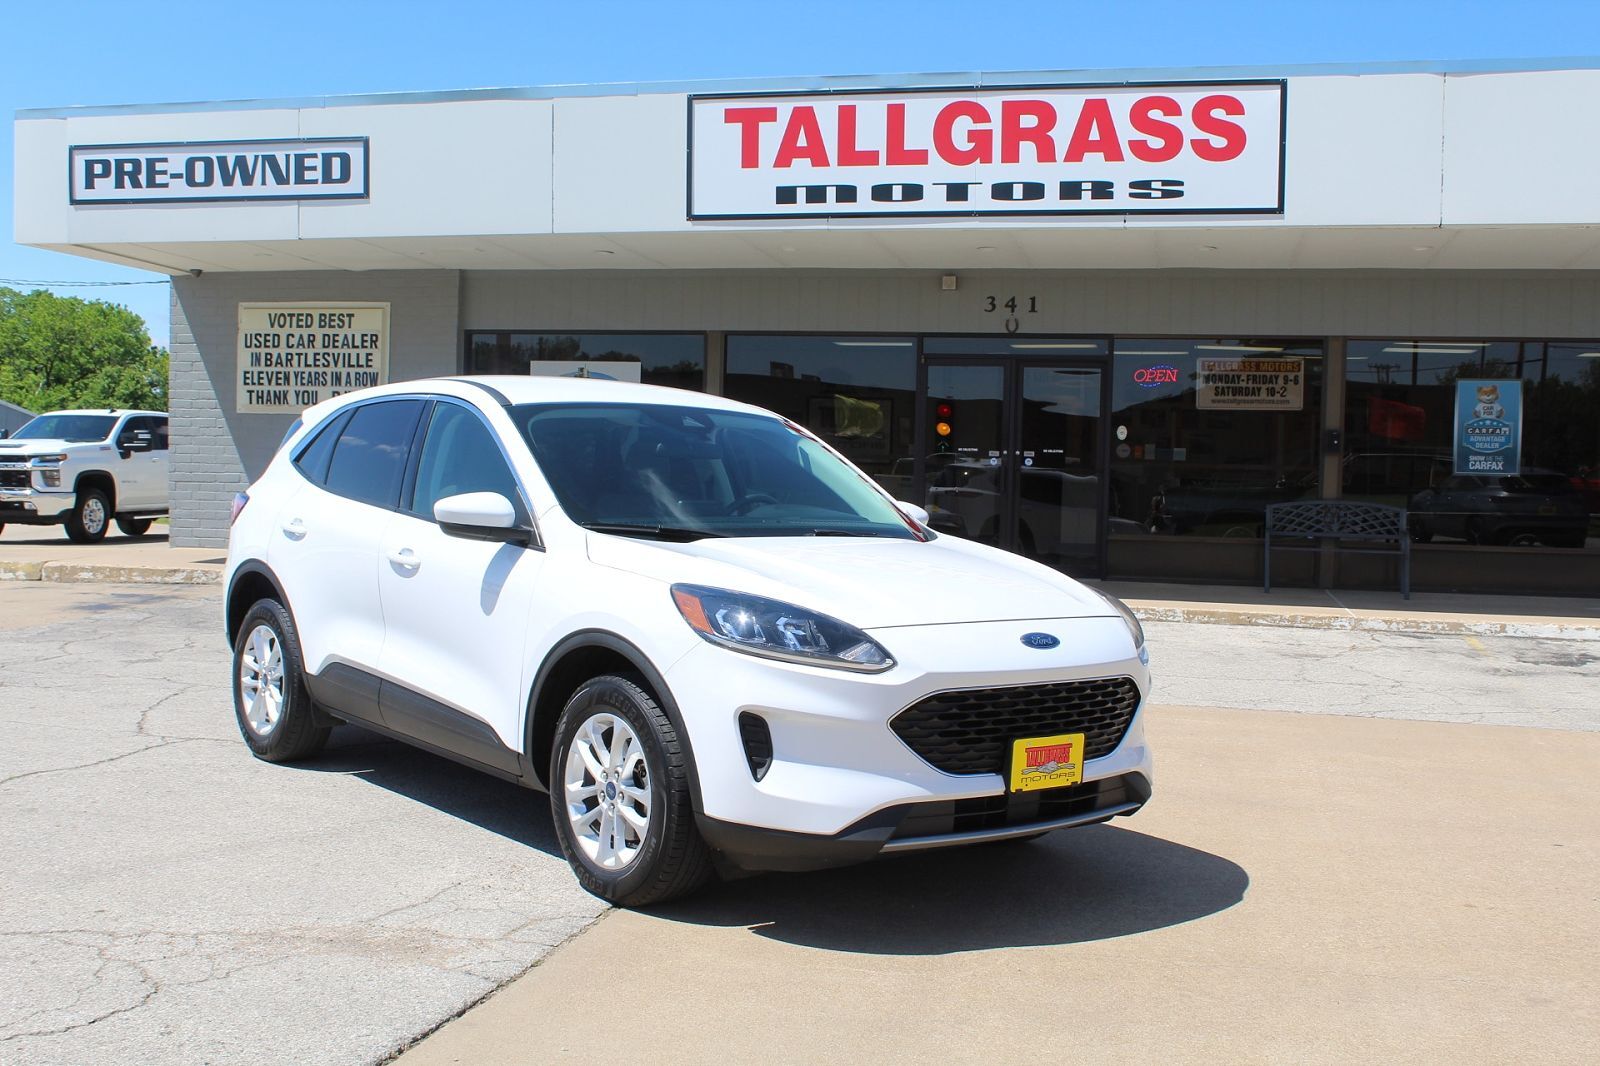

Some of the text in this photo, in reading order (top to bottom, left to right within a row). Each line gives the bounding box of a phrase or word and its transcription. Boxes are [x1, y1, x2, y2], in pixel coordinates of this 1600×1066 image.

[724, 94, 1247, 169] TALLGRASS
[84, 151, 352, 190] PRE-OWNED
[775, 179, 1185, 205] MOTORS
[984, 295, 1039, 313] 341
[268, 313, 355, 329] VOTED BEST
[244, 333, 379, 349] USED CAR DEALER
[250, 352, 373, 368] IN BARTLESVILLE
[1203, 360, 1299, 372] TALLGRASS MOTORS
[243, 371, 379, 387] ELEVEN YEARS IN A ROW
[1134, 369, 1179, 382] OPEN
[1203, 374, 1299, 385] MONDAY-FRIDAY 9-6
[247, 390, 289, 405] THANK
[294, 390, 318, 405] YOU
[1214, 386, 1287, 397] SATURDAY 10-2
[1469, 461, 1504, 470] CARFAX
[1031, 634, 1054, 646] Ford
[1021, 771, 1076, 784] MOTORS
